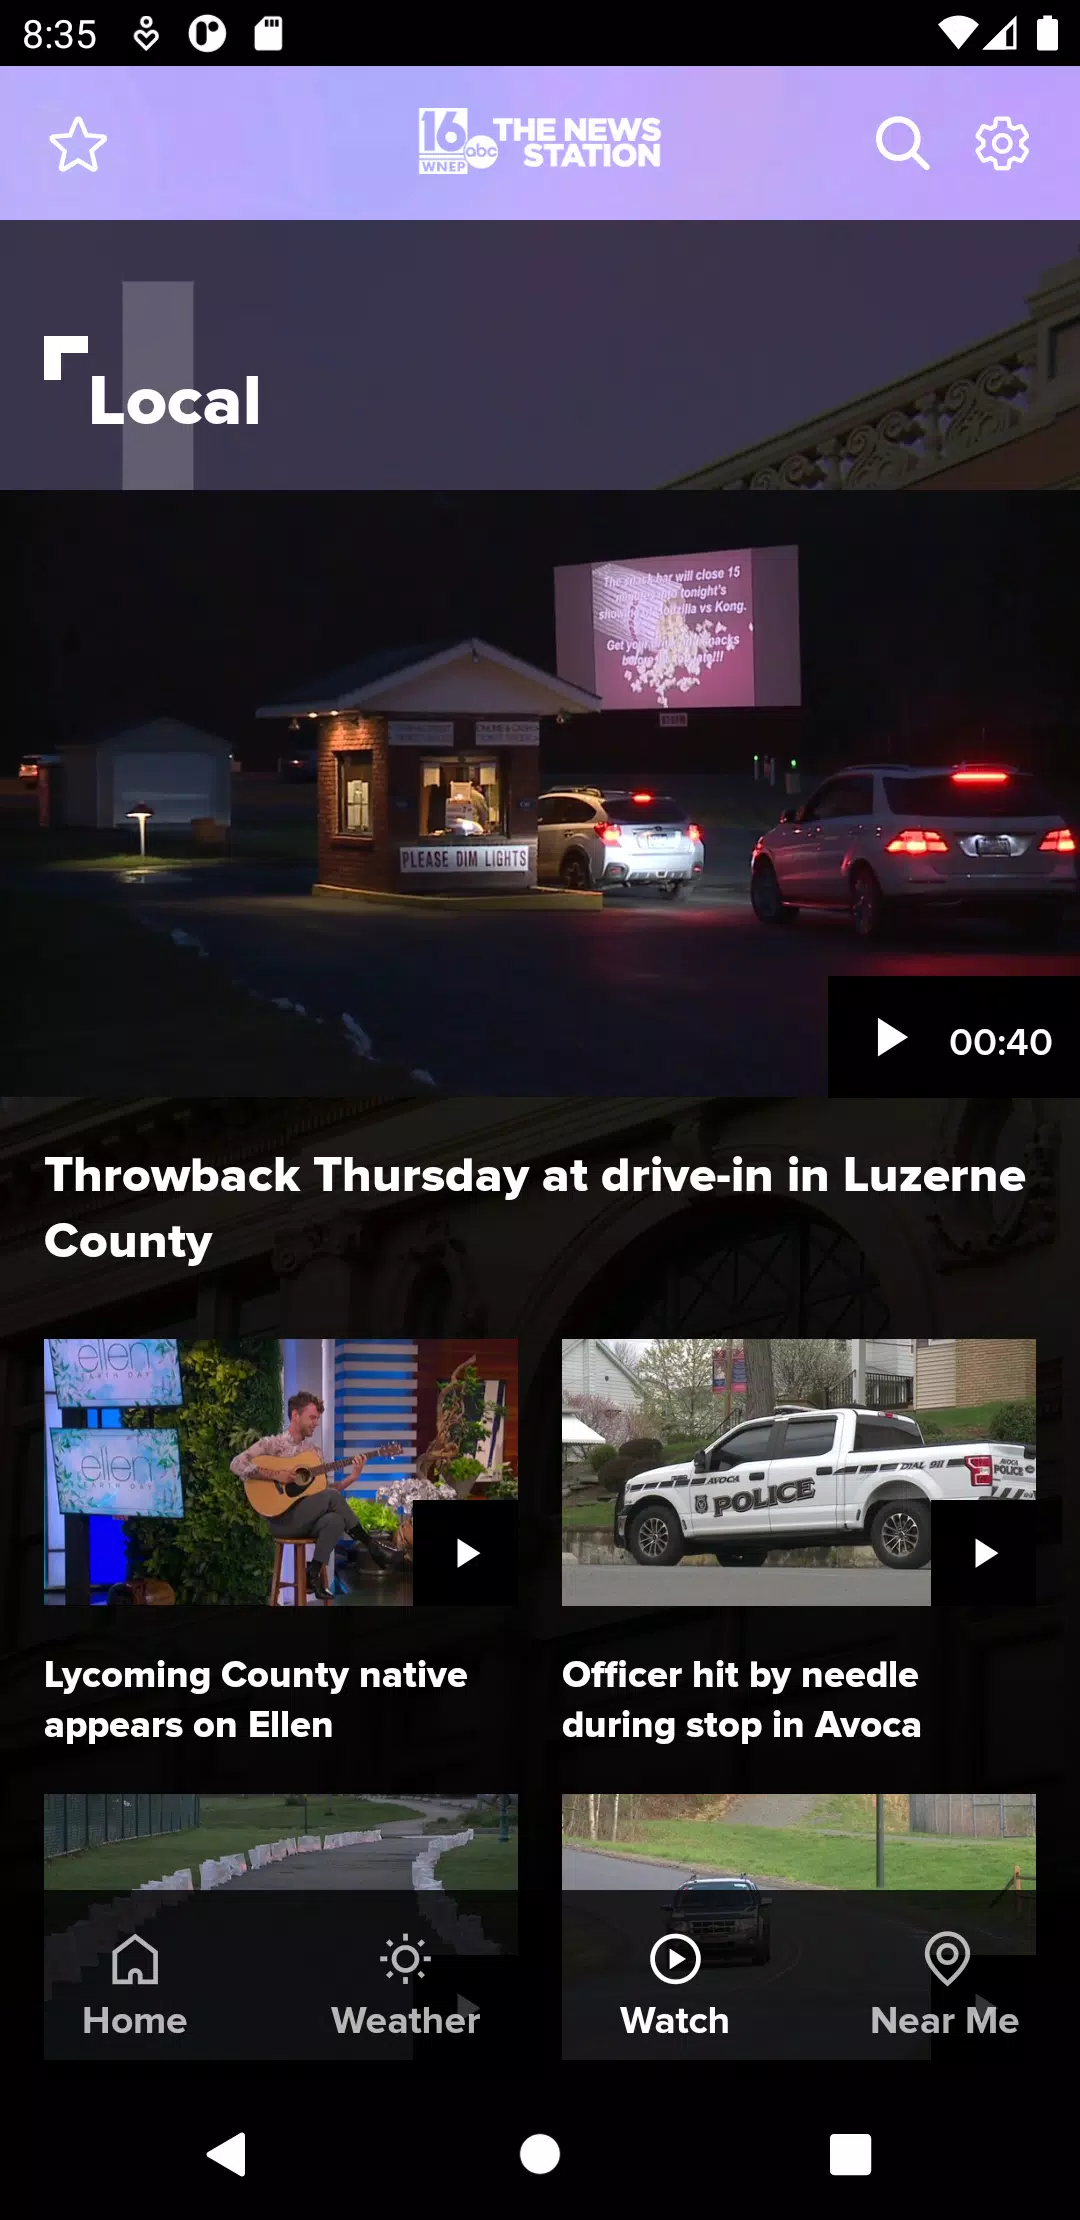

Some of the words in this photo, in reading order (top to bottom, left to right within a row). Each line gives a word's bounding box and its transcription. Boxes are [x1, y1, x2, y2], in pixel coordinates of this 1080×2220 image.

[23, 19, 97, 50] 8:35
[420, 110, 467, 152] 16
[492, 117, 557, 142] THE
[565, 117, 662, 142] NEWS
[465, 142, 498, 158] abc
[523, 143, 661, 168] STATION
[422, 161, 466, 172] WNEP
[91, 375, 259, 425] Local
[675, 570, 693, 583] will
[696, 567, 725, 580] close
[728, 566, 741, 578] 15
[681, 584, 727, 600] tonight's
[699, 604, 712, 614] vs
[715, 601, 747, 615] Kong.
[607, 640, 624, 651] Get
[402, 851, 449, 868] PLEASE
[456, 851, 478, 867] DIM
[484, 850, 527, 867] LIGHTS
[950, 1028, 1053, 1056] 00:40
[44, 1156, 301, 1192] Throwback
[313, 1156, 531, 1201] Thursday
[543, 1159, 589, 1192] at
[601, 1155, 772, 1192] drive-in
[788, 1155, 828, 1192] in
[845, 1156, 1026, 1192] Luzerne
[44, 1222, 214, 1267] County
[77, 1339, 151, 1372] ellen
[81, 1447, 153, 1482] ellen
[900, 1461, 925, 1470] DIAL
[929, 1459, 945, 1469] 911
[994, 1464, 1024, 1476] POLICE
[999, 1458, 1019, 1466] AVOCA
[130, 1482, 153, 1490] DAY
[706, 1475, 741, 1485] AVOCA
[712, 1477, 816, 1518] POLICE
[45, 1659, 210, 1695] Lycoming
[221, 1660, 350, 1695] County
[360, 1659, 468, 1688] native
[562, 1659, 683, 1688] Officer
[693, 1659, 739, 1688] hit
[750, 1660, 792, 1695] by
[802, 1660, 919, 1688] needle
[44, 1717, 184, 1745] appears
[193, 1717, 237, 1738] on
[249, 1710, 333, 1738] Ellen
[562, 1709, 675, 1745] during
[686, 1712, 763, 1745] stop
[773, 1709, 804, 1738] in
[814, 1710, 921, 1738] Avoca
[83, 2006, 188, 2034] Home
[330, 2006, 481, 2034] Weather
[619, 2006, 729, 2034] Watch
[871, 2006, 956, 2034] Near
[966, 2006, 1019, 2034] Me
